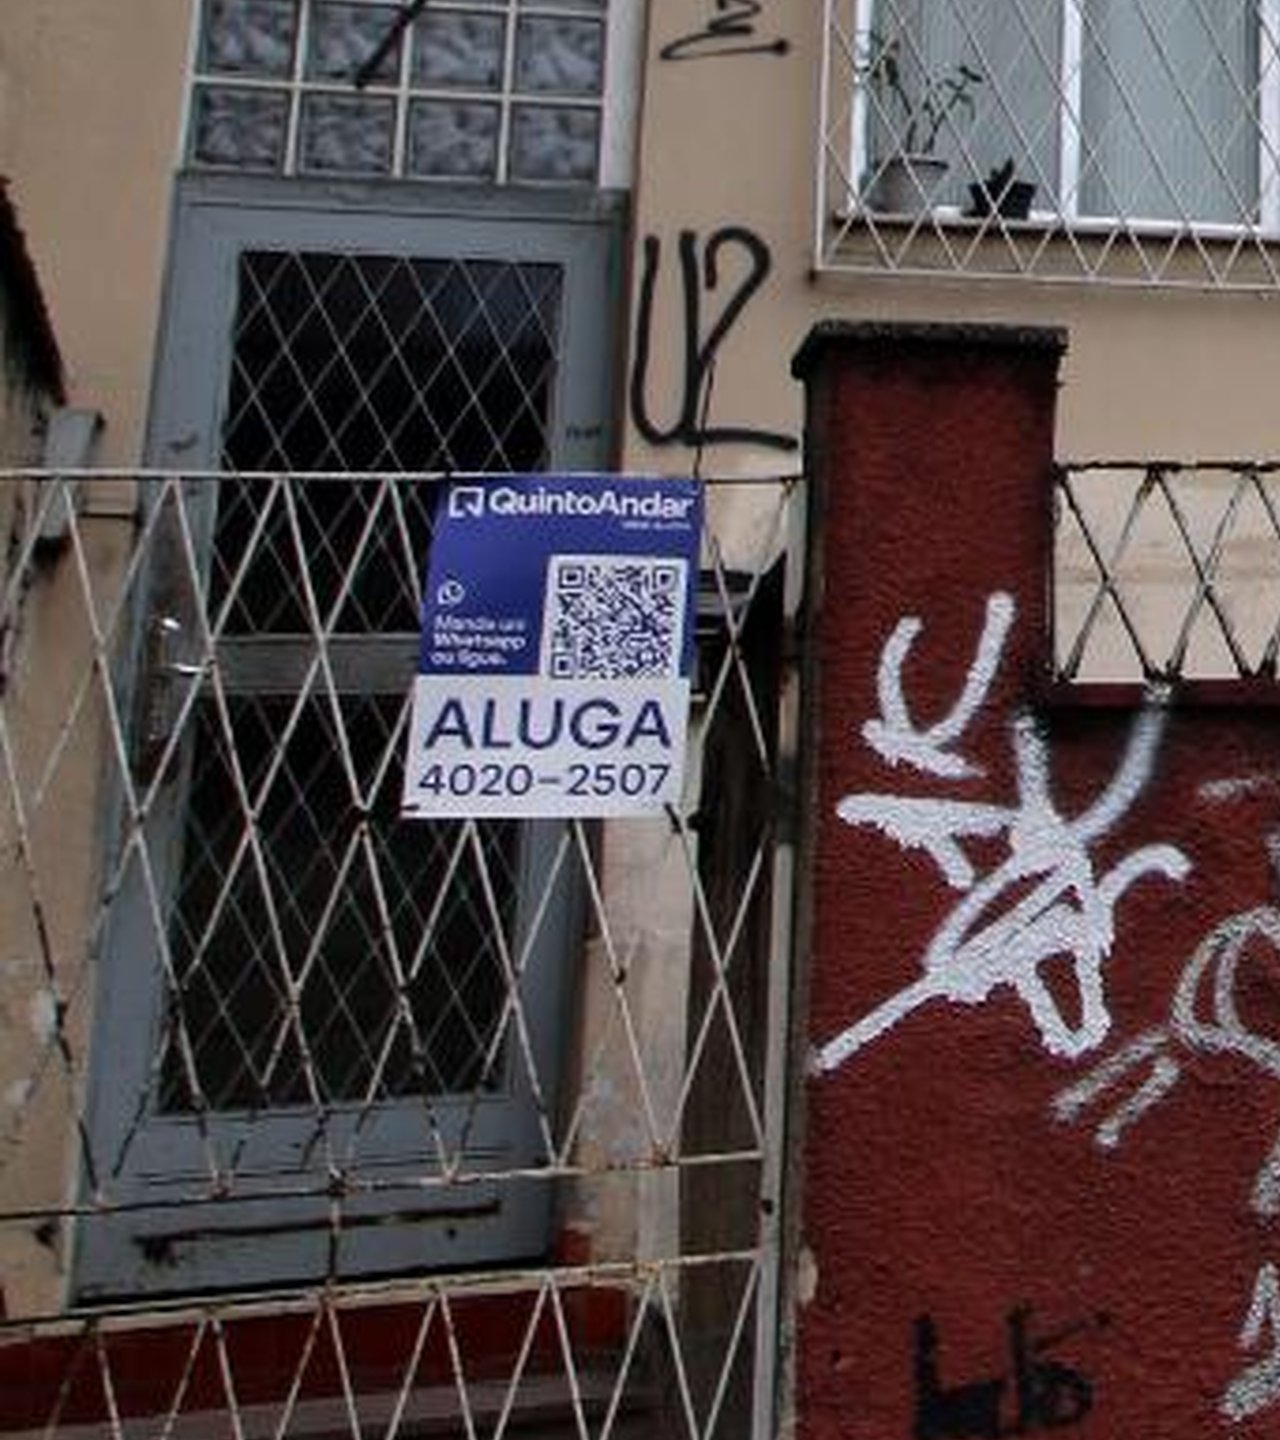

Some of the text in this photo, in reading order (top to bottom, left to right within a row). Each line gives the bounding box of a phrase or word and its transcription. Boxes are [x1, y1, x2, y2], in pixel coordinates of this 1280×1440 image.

[488, 488, 695, 519] QuintoAndar
[430, 651, 455, 666] ou
[424, 698, 672, 751] ALUGA
[419, 763, 672, 797] 4020-2507
